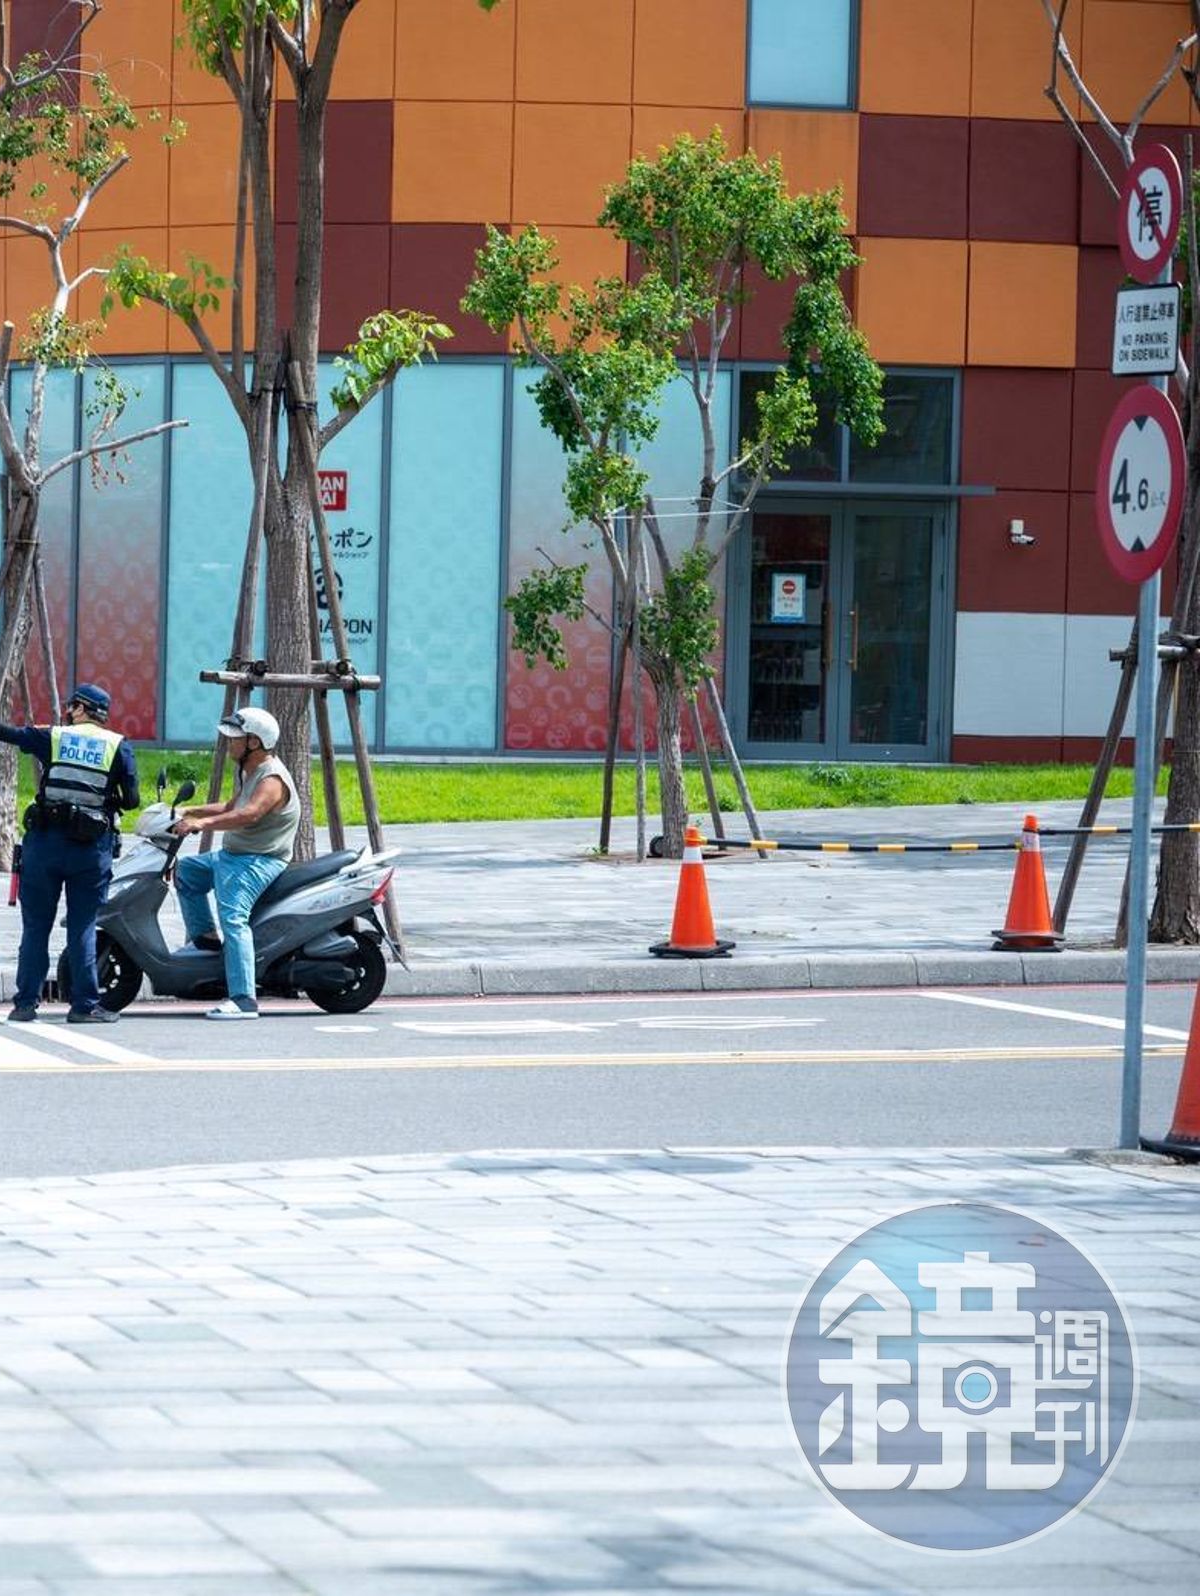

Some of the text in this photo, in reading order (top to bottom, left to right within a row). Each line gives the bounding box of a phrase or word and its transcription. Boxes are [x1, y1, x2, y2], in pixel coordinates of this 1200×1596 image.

[1136, 185, 1163, 243] 停
[1119, 301, 1175, 323] 人行道禁止停車
[1122, 331, 1169, 346] NO PARKING
[1118, 347, 1171, 362] ON SIDEWALK
[1112, 458, 1149, 515] 4.6
[60, 745, 103, 765] POLICE
